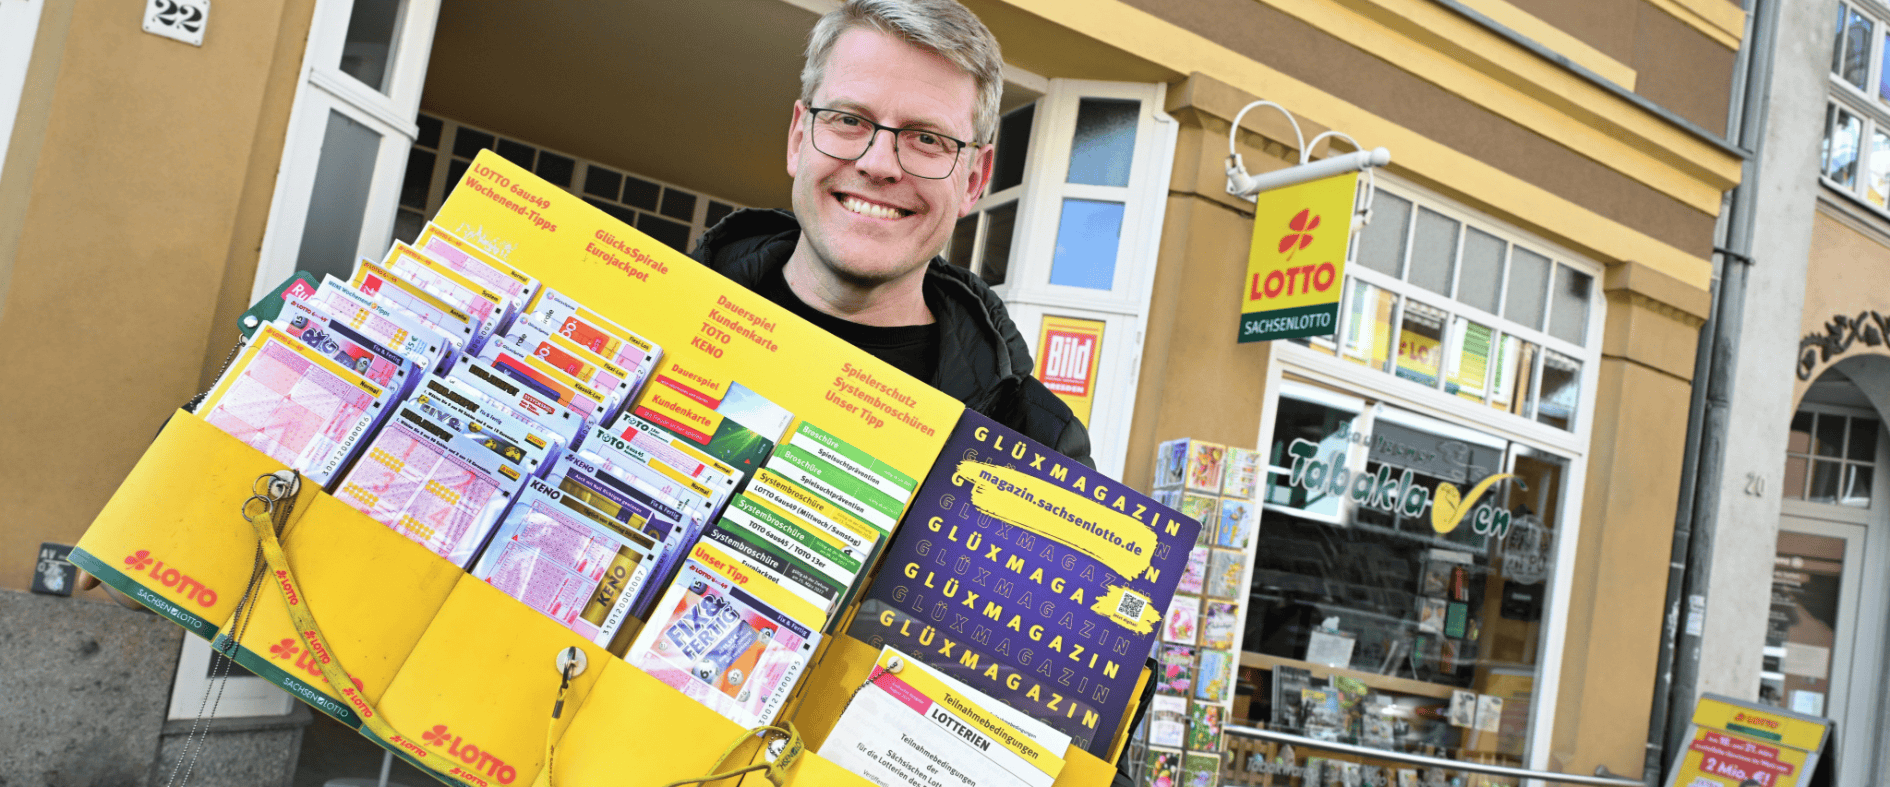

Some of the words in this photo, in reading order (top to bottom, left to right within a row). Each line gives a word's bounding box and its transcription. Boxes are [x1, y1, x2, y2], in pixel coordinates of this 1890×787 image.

[152, 0, 203, 32] 22
[465, 176, 557, 233] Wochenend-Tipps
[474, 163, 510, 188] LOTTO
[510, 183, 551, 210] 6aus49
[585, 242, 649, 282] Eurojackpot
[594, 229, 669, 275] GlücksSpirale
[481, 289, 499, 302] System
[1250, 261, 1336, 301] LOTTO
[341, 286, 372, 307] Wochenend
[374, 305, 390, 318] Tipps
[717, 295, 776, 333] Dauerspiel
[700, 321, 731, 345] TOTO
[707, 308, 778, 353] Kundenkarte
[1244, 313, 1331, 335] SACHSENLOTTO
[690, 336, 724, 359] KENO
[1046, 335, 1092, 380] Bild
[358, 380, 379, 395] Normal
[574, 382, 601, 400] Klassik-Los
[670, 362, 720, 393] Dauerspiel
[841, 363, 917, 408] Spielerschutz
[1043, 382, 1084, 394] DRESDEN
[489, 414, 502, 425] Fertig
[622, 413, 649, 432] TOTO
[651, 392, 712, 428] Kundenkarte
[824, 389, 858, 414] Unser
[859, 409, 884, 430] Tipp
[833, 376, 935, 437] Systembroschüren
[321, 412, 369, 479] 300120000006
[594, 428, 626, 451] TOTO
[801, 423, 840, 450] Broschüre
[572, 457, 595, 473] KENO
[713, 461, 731, 474] Normal
[783, 449, 823, 476] Broschüre
[817, 446, 880, 488] Spielsuchtprävention
[972, 421, 1182, 537] GLÜXMAGAZIN
[529, 478, 561, 501] KENO
[690, 481, 710, 496] Normal
[753, 482, 775, 500] LOTTO
[773, 493, 798, 512] 6aus49
[759, 469, 825, 514] Systembroschüre
[799, 472, 865, 515] Spielsuchtprävention
[1744, 471, 1765, 498] 20
[737, 497, 806, 543] Systembroschüre
[977, 466, 1144, 559] magazin.sachsenlotto.de
[710, 524, 780, 572] Systembroschüre
[748, 520, 766, 534] TOTO
[764, 528, 789, 547] 6aus45
[792, 545, 811, 560] TOTO
[810, 555, 826, 568] 13er
[149, 561, 218, 608] LOTTO
[694, 546, 727, 571] Unser
[723, 564, 750, 586] Tipp
[694, 567, 712, 580] LOTTO
[281, 578, 298, 605] LOTTO
[596, 565, 627, 608] KENO
[913, 533, 1132, 656] GLÜXMAGAZIN
[682, 607, 740, 661] FERTIG
[776, 614, 786, 623] Fix
[789, 622, 808, 637] Fertig
[901, 556, 1122, 679] GLÜXMAGAZIN
[310, 637, 331, 664] LOTTO
[889, 579, 1112, 704] GLÜXMAGAZIN
[877, 604, 1101, 729] GLÜXMAGAZIN
[350, 695, 373, 718] LOTTO
[929, 707, 992, 751] LOTTERIEN
[940, 692, 1041, 760] Teilnahmebedingungen
[400, 739, 427, 758] LOTTO
[447, 736, 517, 785] LOTTO
[857, 742, 867, 753] für
[866, 749, 878, 760] die
[879, 757, 908, 780] Lotterien
[908, 777, 921, 787] des
[886, 749, 927, 781] Sächsischen
[900, 733, 976, 787] Teilnahmebedingungen
[460, 770, 488, 787] LOTTO
[926, 764, 939, 775] der
[1705, 756, 1717, 771] 2
[1716, 761, 1750, 780] Mio.
